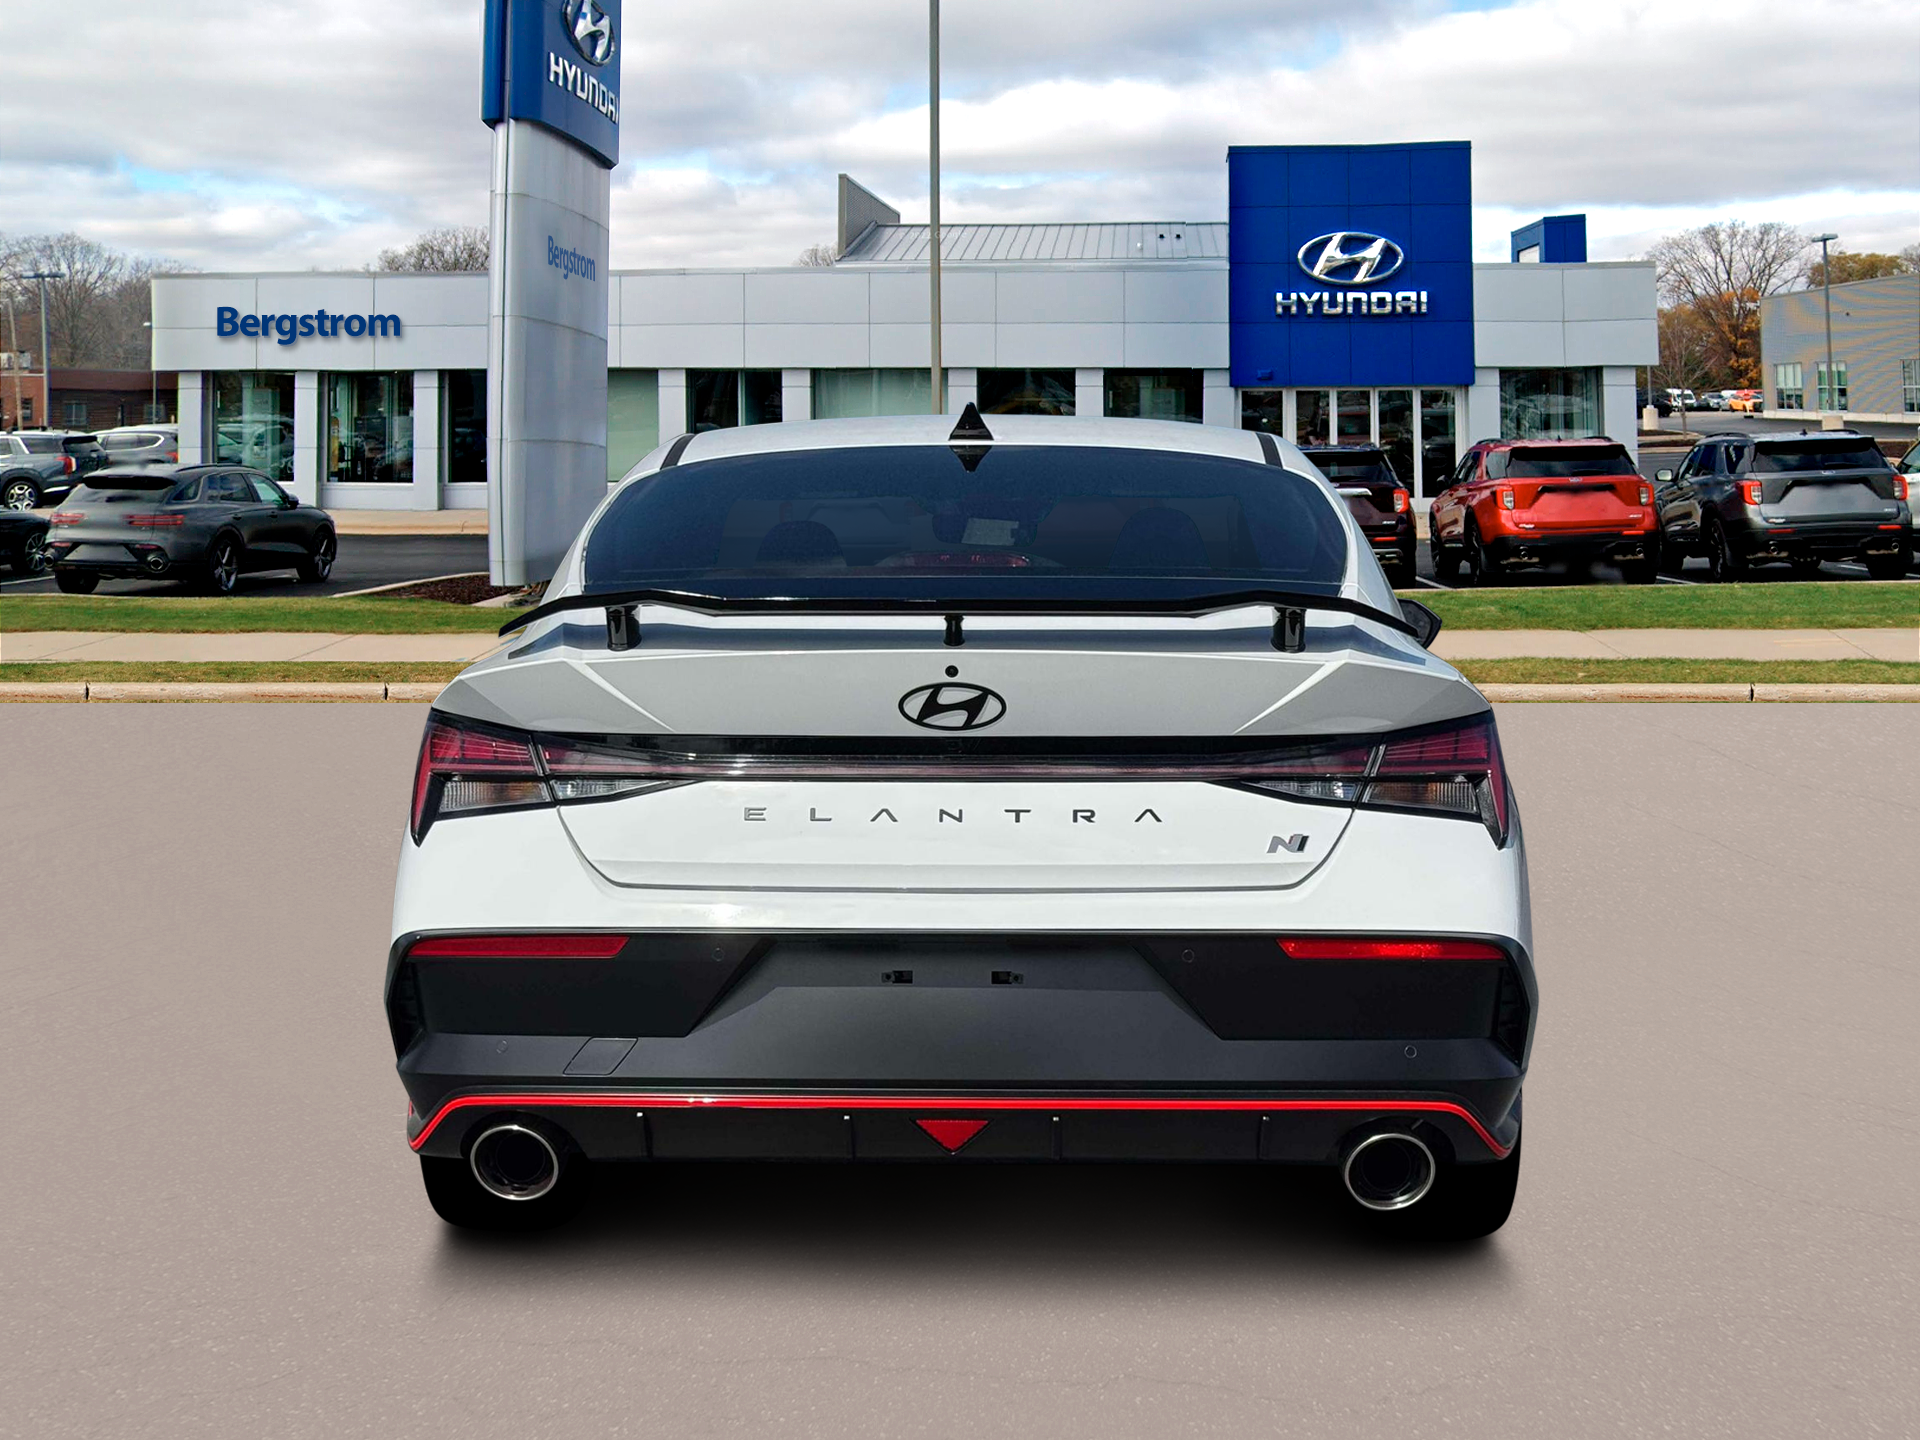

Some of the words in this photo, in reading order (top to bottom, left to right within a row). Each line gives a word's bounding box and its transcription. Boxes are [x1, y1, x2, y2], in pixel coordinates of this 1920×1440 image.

[549, 51, 619, 124] HYUNDAI
[547, 235, 596, 281] Bergstrom
[1275, 291, 1428, 315] HYUNDAI
[216, 306, 401, 346] Bergstrom
[743, 807, 1163, 823] ELANTRA
